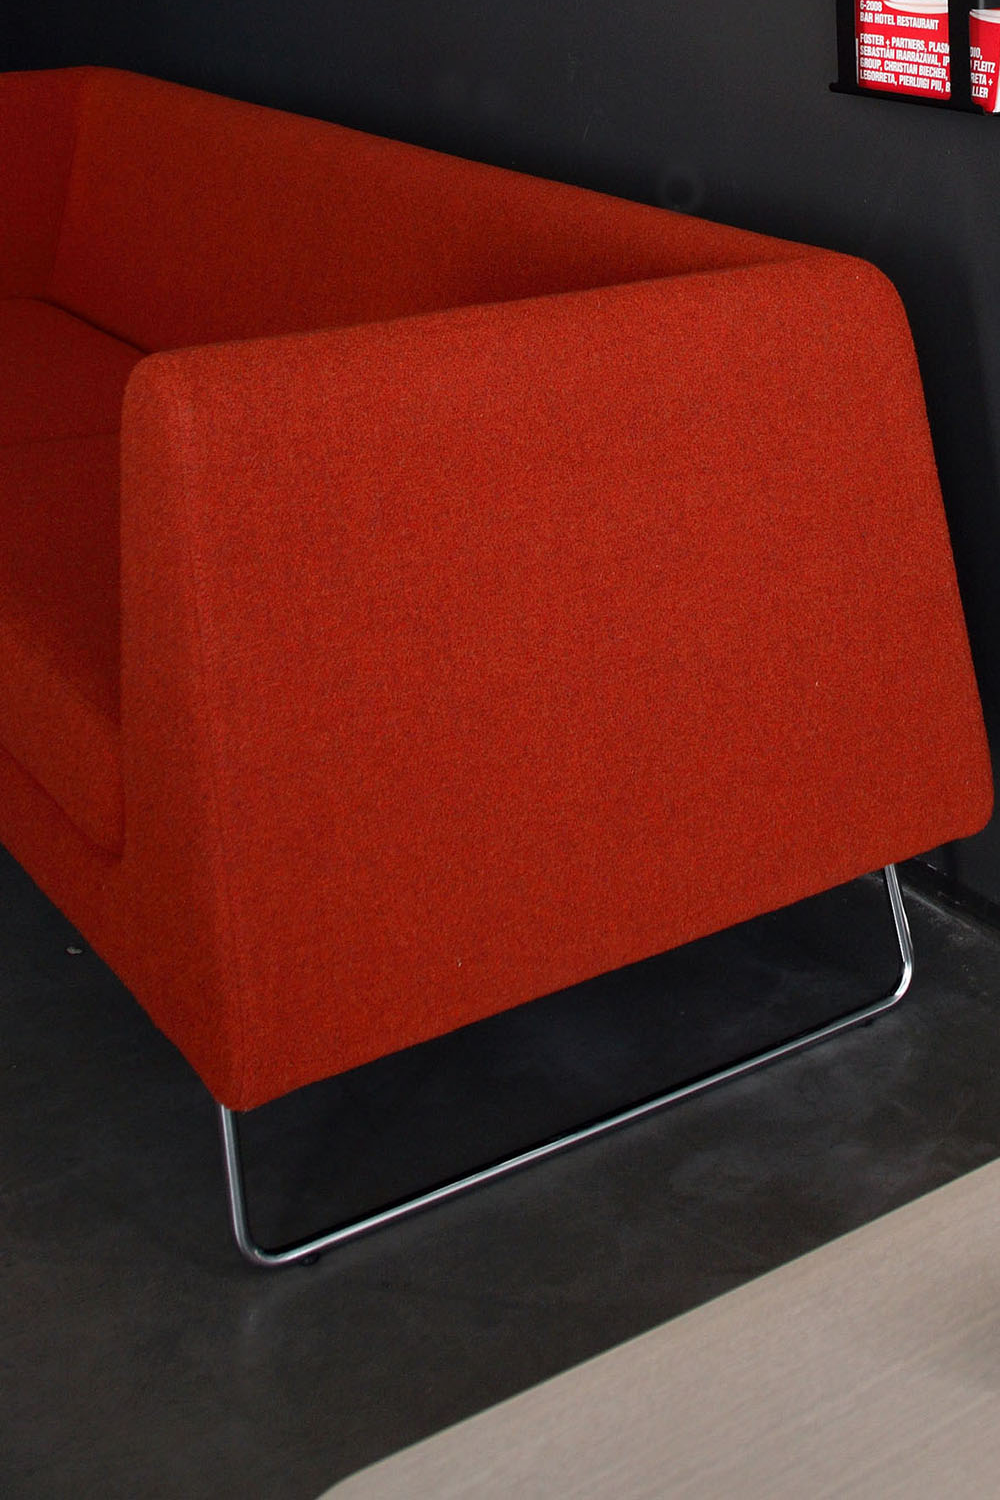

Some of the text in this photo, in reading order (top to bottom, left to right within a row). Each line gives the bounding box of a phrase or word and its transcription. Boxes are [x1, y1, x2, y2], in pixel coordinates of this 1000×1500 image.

[860, 0, 883, 12] 6-2008
[860, 11, 940, 31] BAR HOTEL RESTAURANT
[860, 33, 884, 46] FOSTER
[891, 36, 927, 52] PARTNERS,
[884, 60, 918, 75] CHRISTIAN
[974, 60, 996, 73] FLEITZ
[899, 74, 929, 89] PIERLUIGI
